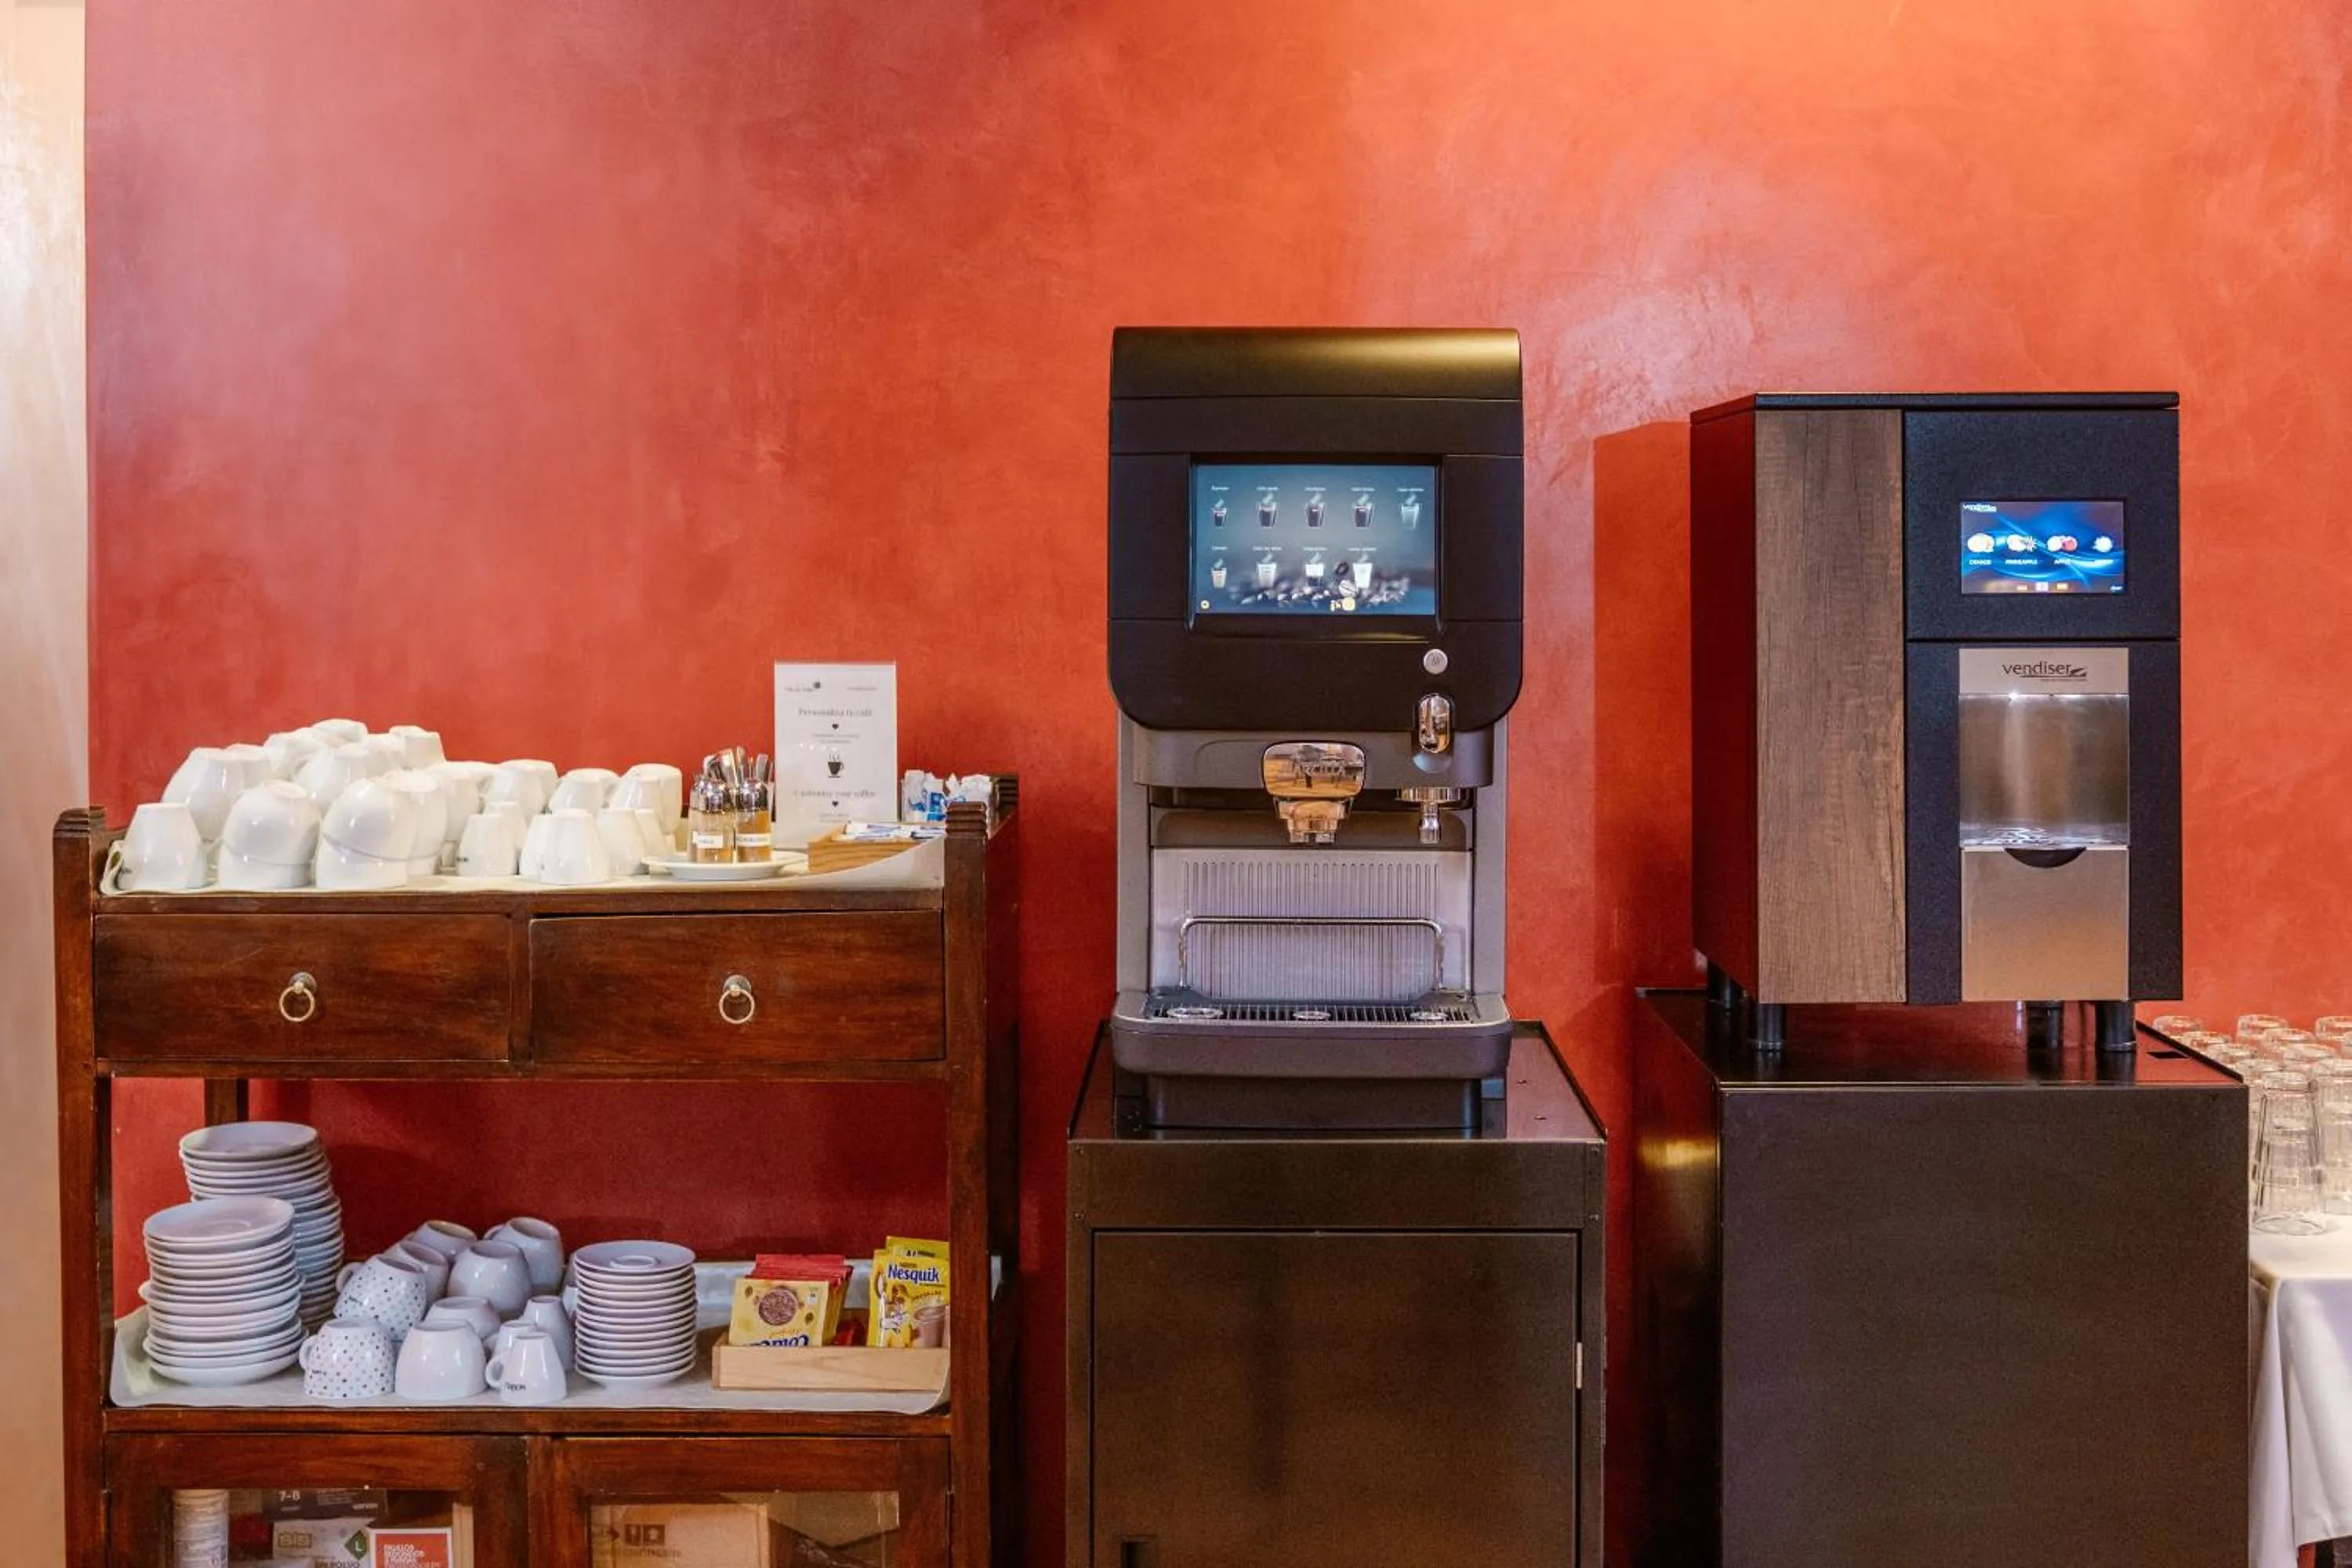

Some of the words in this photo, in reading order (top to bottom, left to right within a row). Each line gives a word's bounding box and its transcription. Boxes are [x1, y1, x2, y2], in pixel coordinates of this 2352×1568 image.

[2002, 661, 2072, 675] vendiser
[887, 1262, 940, 1284] Nesquik
[354, 1541, 364, 1552] L
